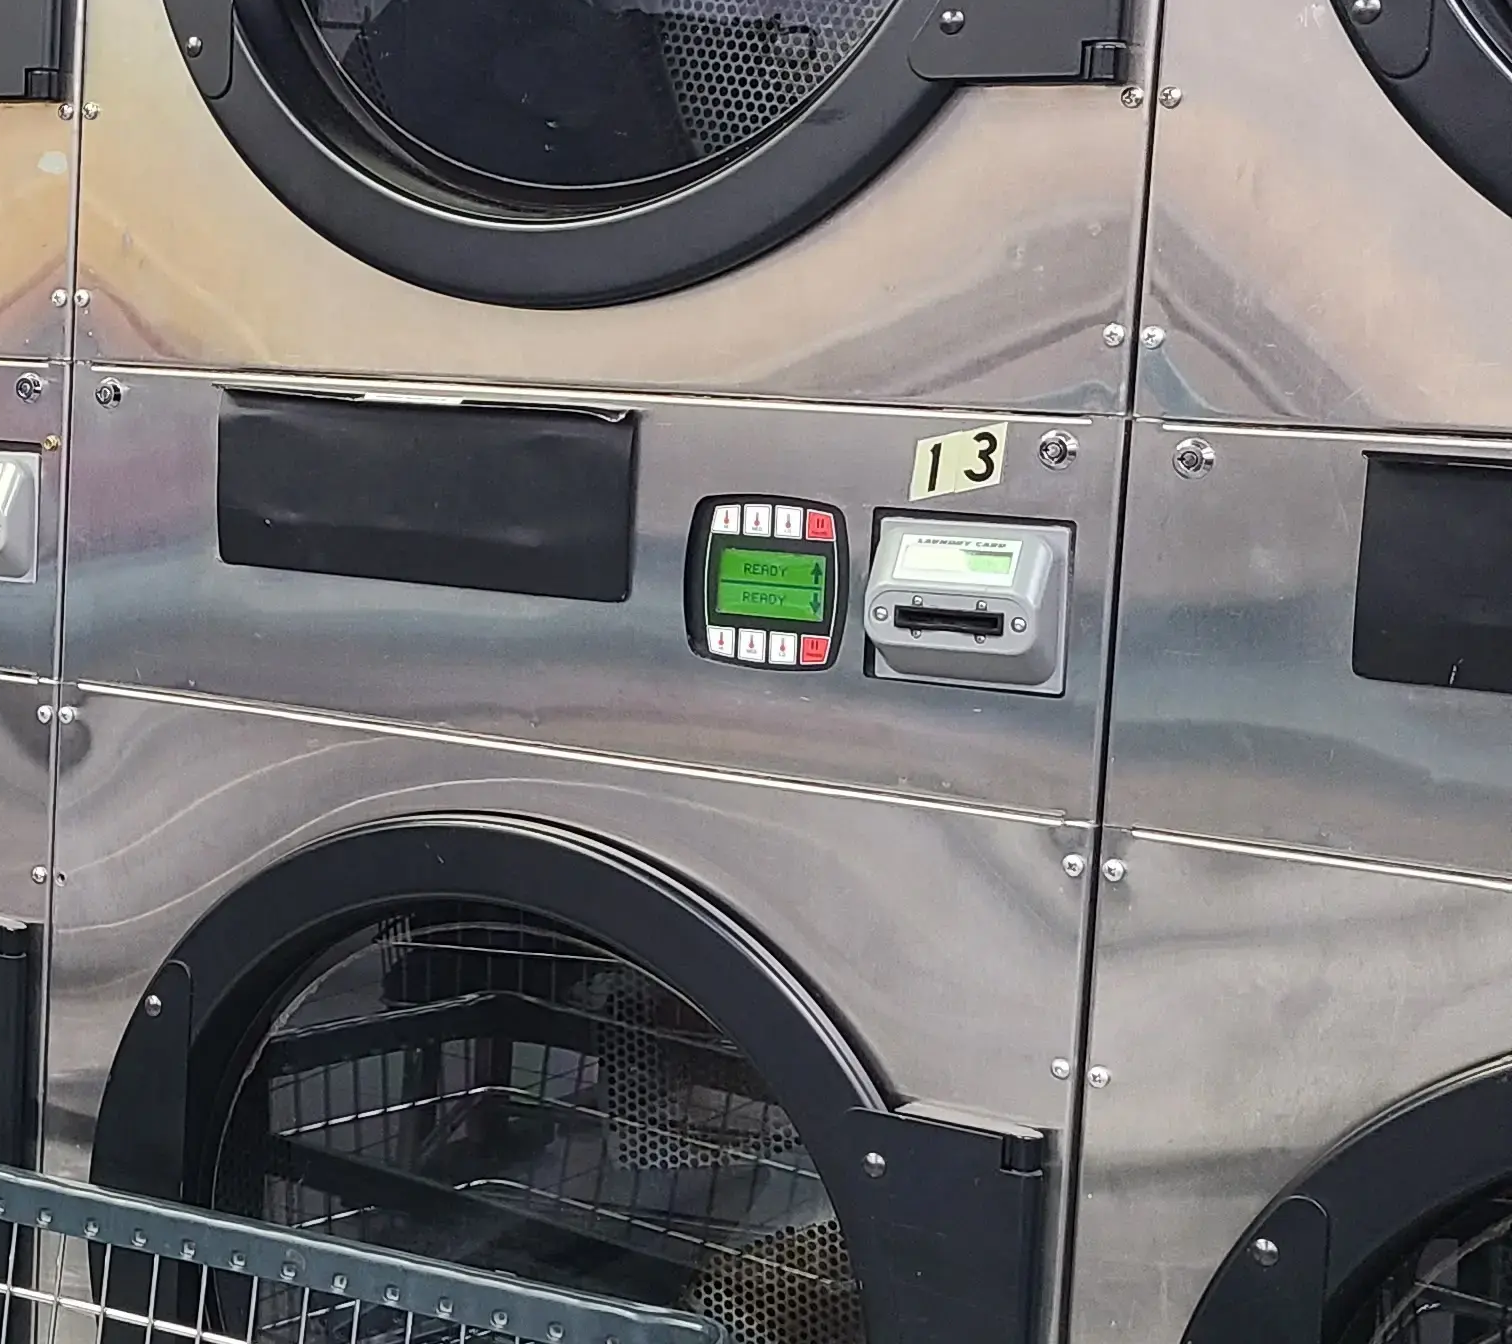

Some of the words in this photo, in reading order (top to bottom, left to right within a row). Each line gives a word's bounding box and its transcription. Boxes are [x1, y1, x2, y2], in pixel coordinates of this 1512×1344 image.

[927, 431, 998, 493] 13
[744, 562, 788, 578] READY
[742, 591, 787, 607] READY
